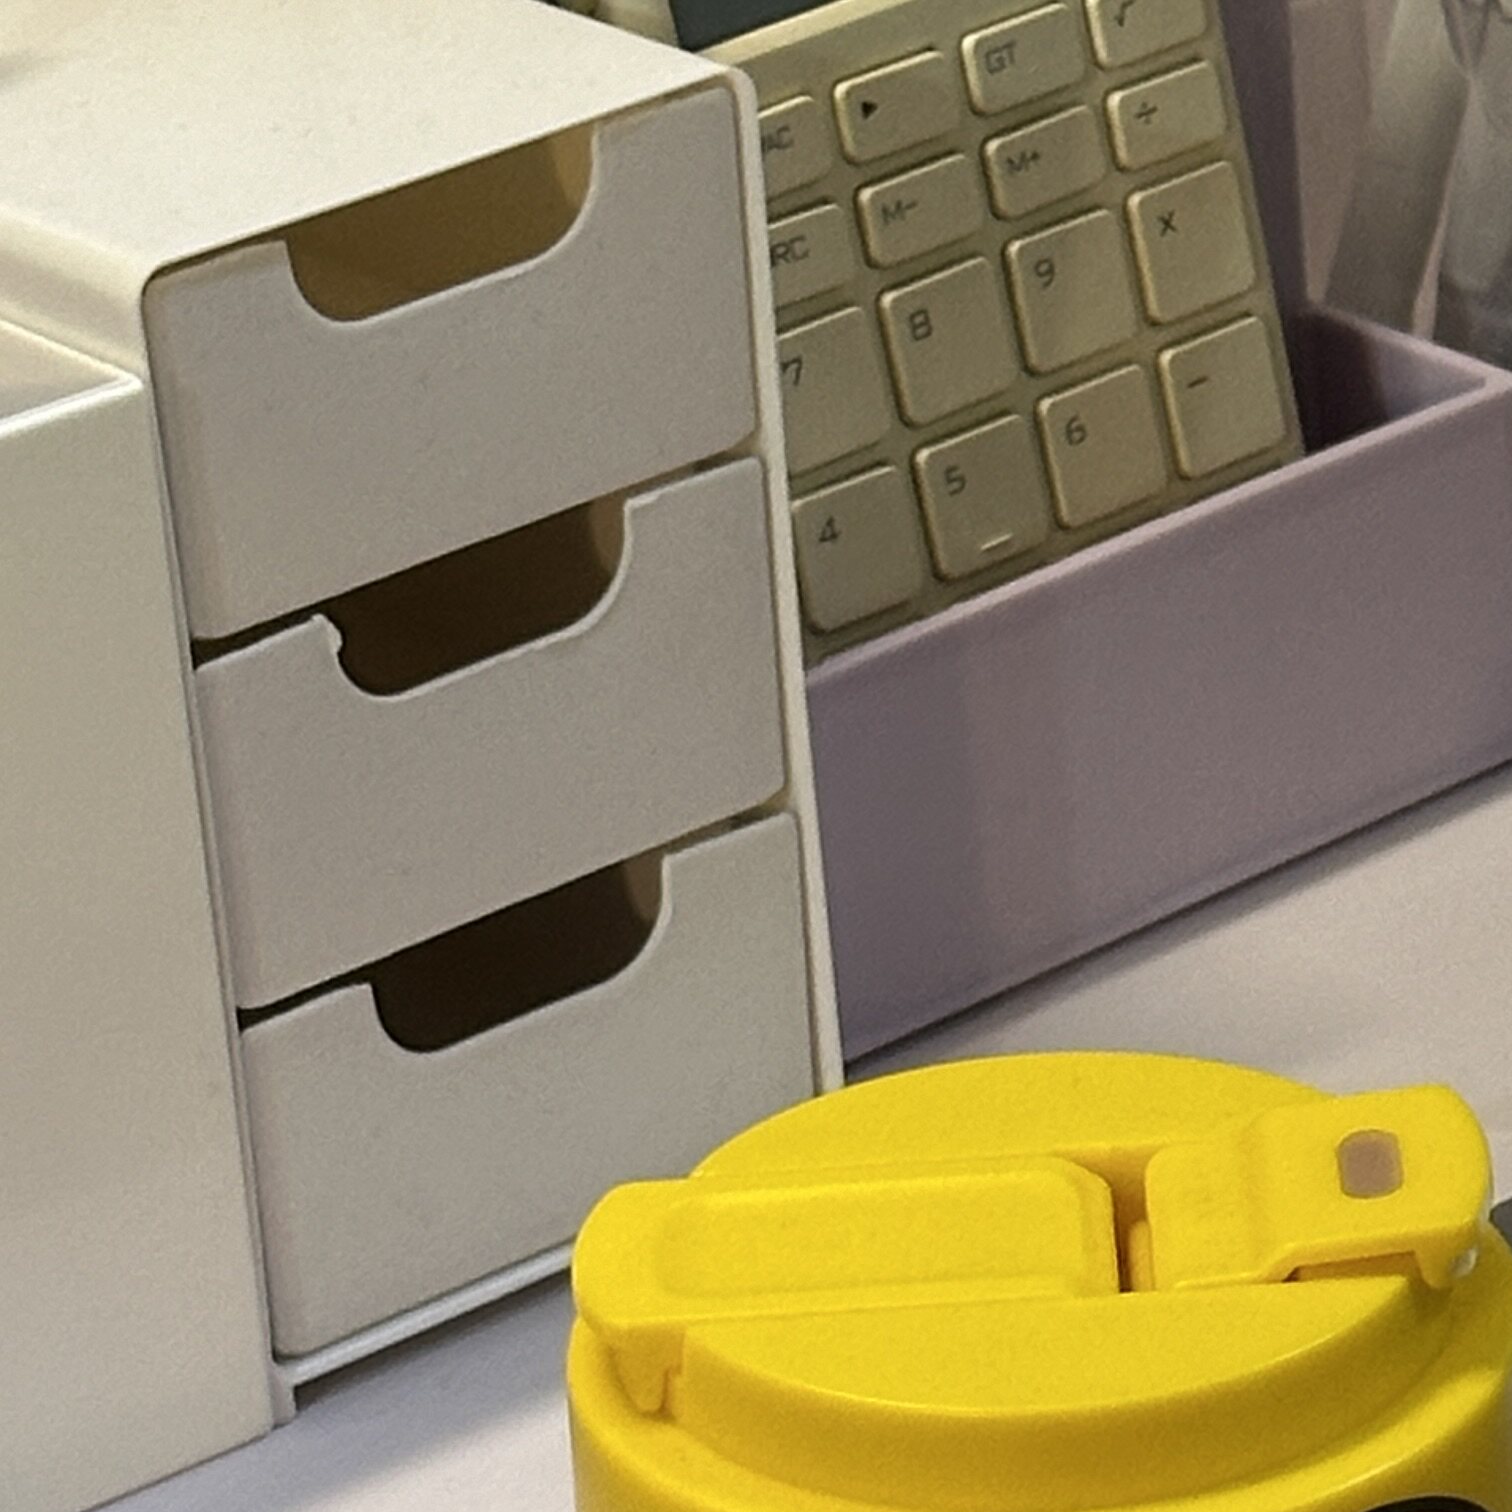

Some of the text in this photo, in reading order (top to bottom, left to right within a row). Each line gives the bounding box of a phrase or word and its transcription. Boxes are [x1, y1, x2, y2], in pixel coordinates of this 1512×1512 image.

[985, 40, 1016, 75] GT
[1007, 151, 1041, 174] M+
[1034, 258, 1055, 288] 9
[909, 308, 933, 341] 8
[781, 357, 803, 386] 7
[1065, 416, 1088, 446] 6
[945, 466, 966, 496] 5
[818, 516, 839, 544] 4
